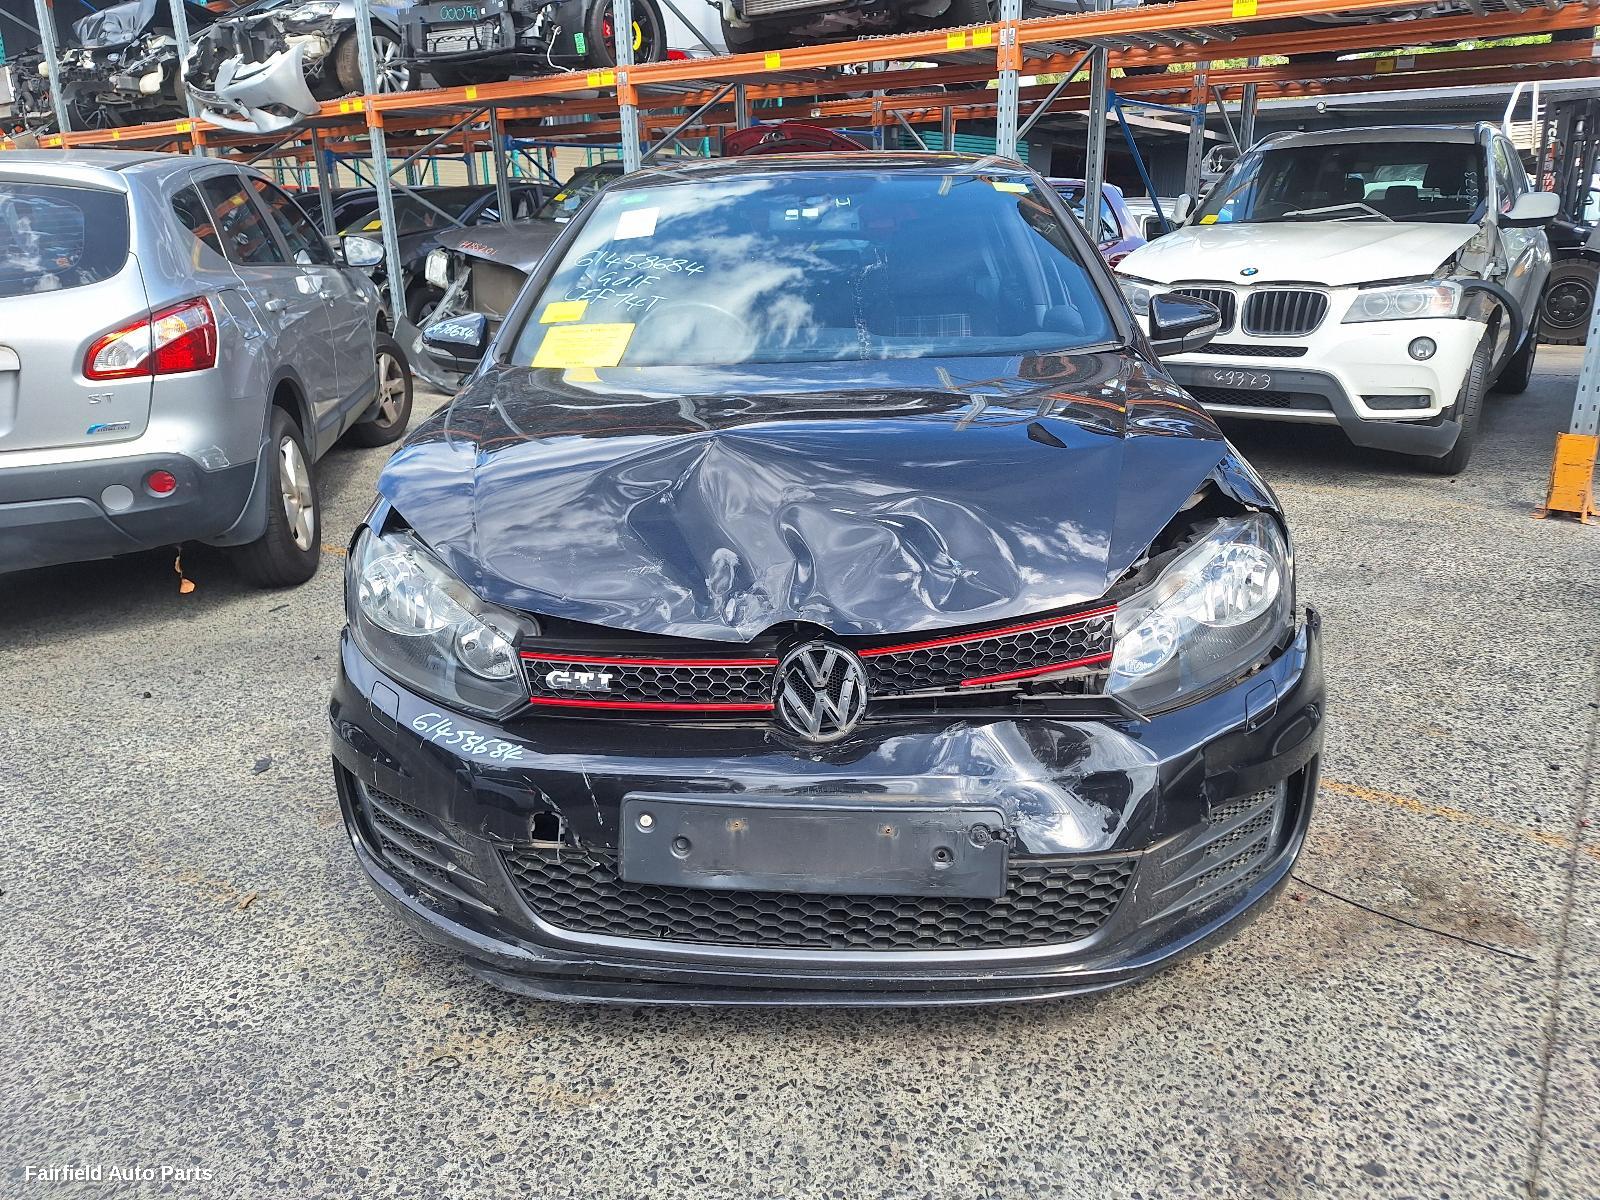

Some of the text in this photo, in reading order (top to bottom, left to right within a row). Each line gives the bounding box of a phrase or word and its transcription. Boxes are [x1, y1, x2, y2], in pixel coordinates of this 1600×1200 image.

[575, 250, 705, 276] 61458684
[88, 392, 114, 404] ST
[546, 671, 613, 692] GTI
[413, 713, 523, 761] 61458684
